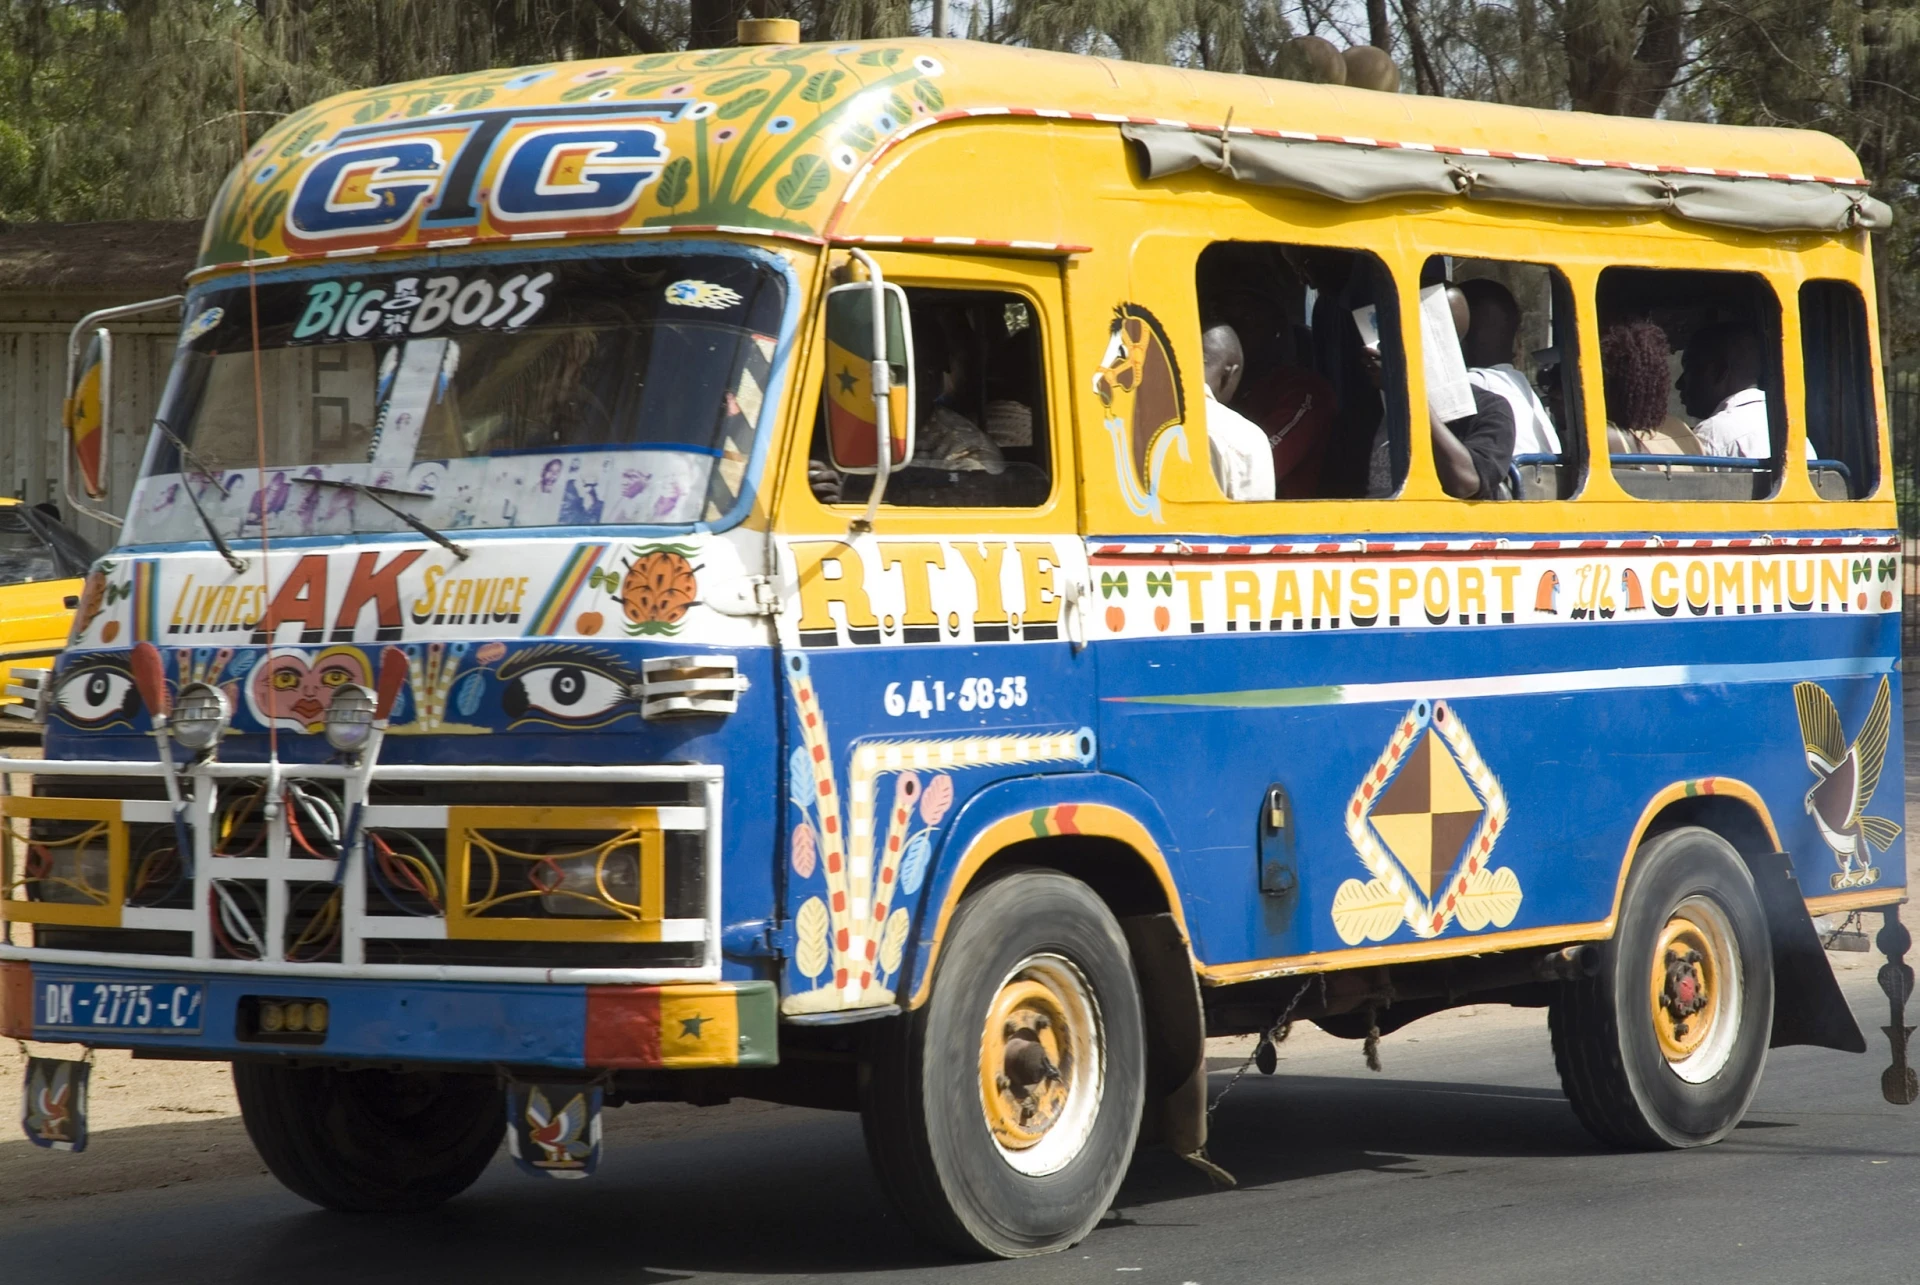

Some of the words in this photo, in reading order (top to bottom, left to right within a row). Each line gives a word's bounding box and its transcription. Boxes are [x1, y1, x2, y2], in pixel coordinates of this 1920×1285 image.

[409, 272, 554, 333] BOSS
[250, 549, 428, 643] AK
[1175, 566, 1522, 633] TRANSPORT
[1651, 558, 1849, 617] COMMUN
